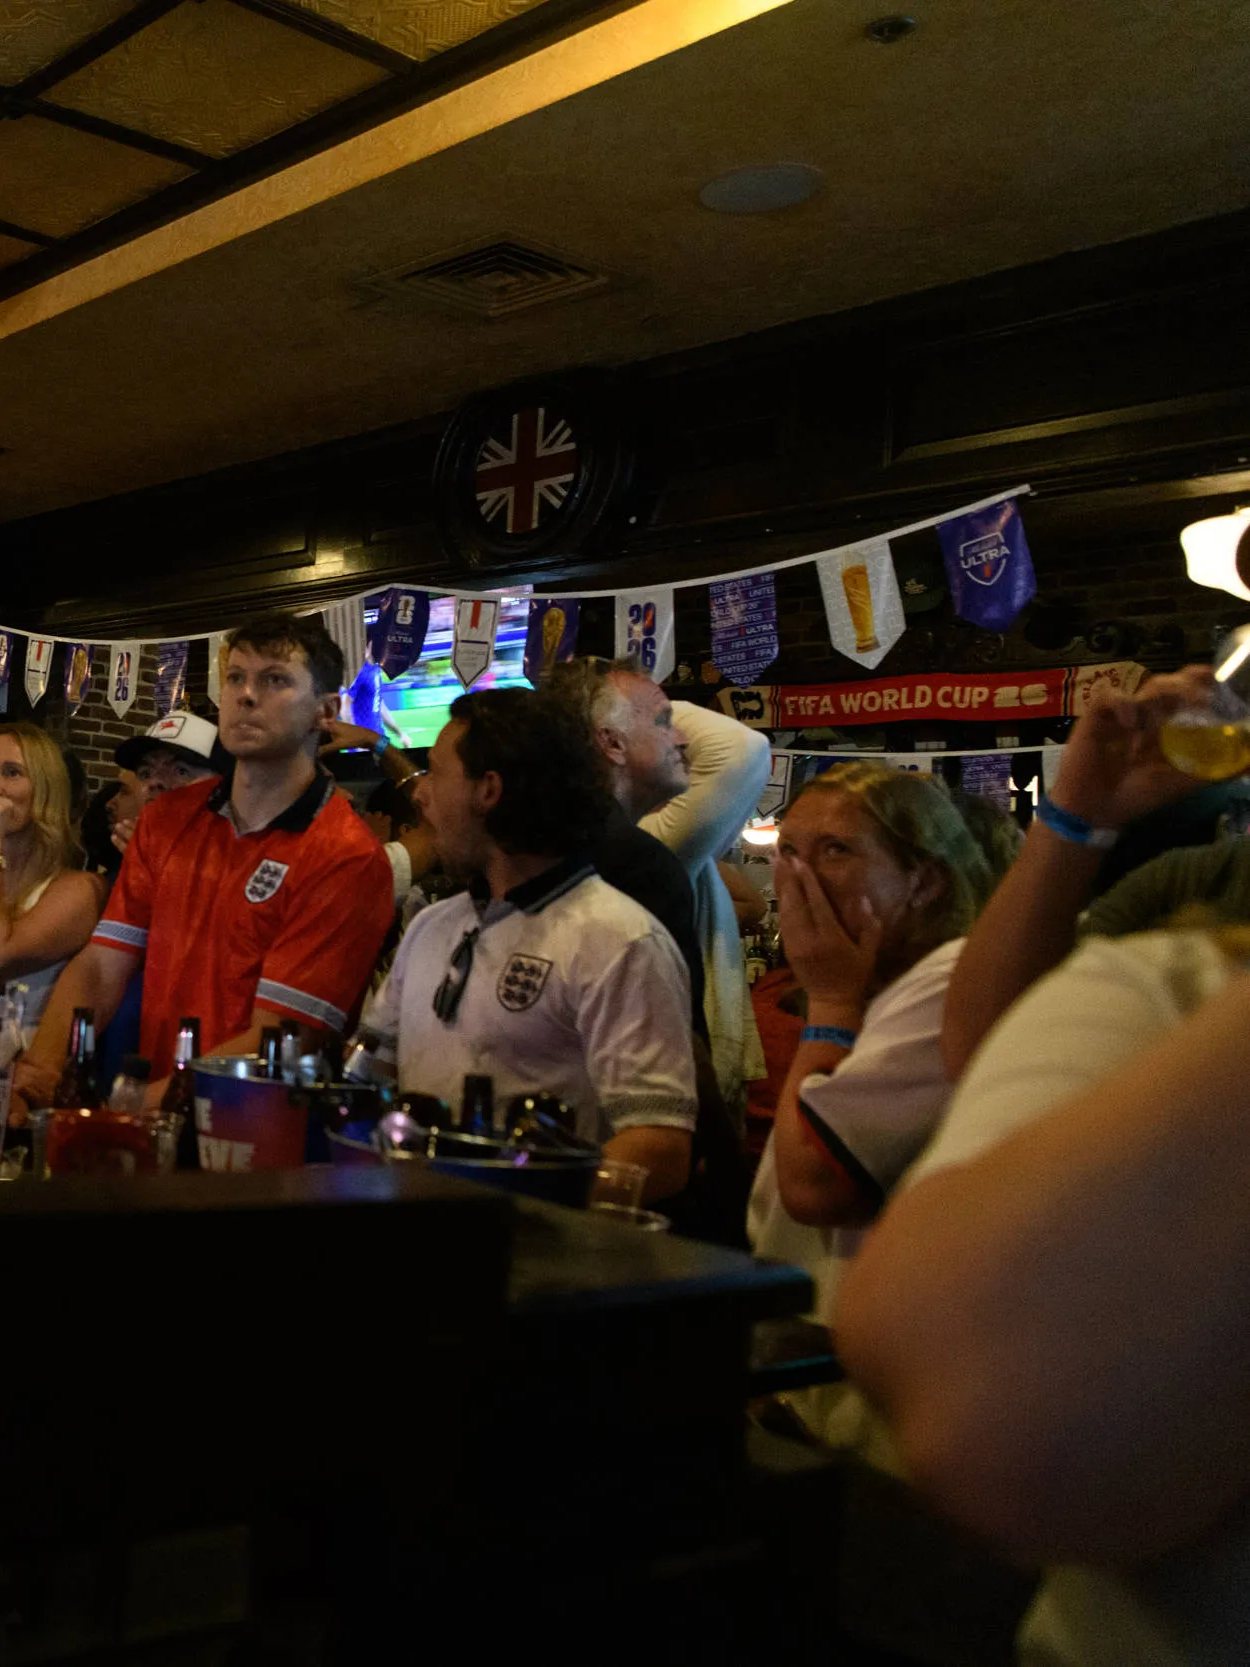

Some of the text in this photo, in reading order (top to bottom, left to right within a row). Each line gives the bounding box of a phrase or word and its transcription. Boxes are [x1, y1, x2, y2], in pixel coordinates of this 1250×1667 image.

[960, 544, 1011, 569] ULTRA
[628, 602, 656, 637] 20
[745, 623, 775, 635] ULTRA
[387, 634, 414, 644] ULTRA
[114, 677, 129, 702] 26
[785, 682, 1049, 717] FIFA WORLD CUP 26
